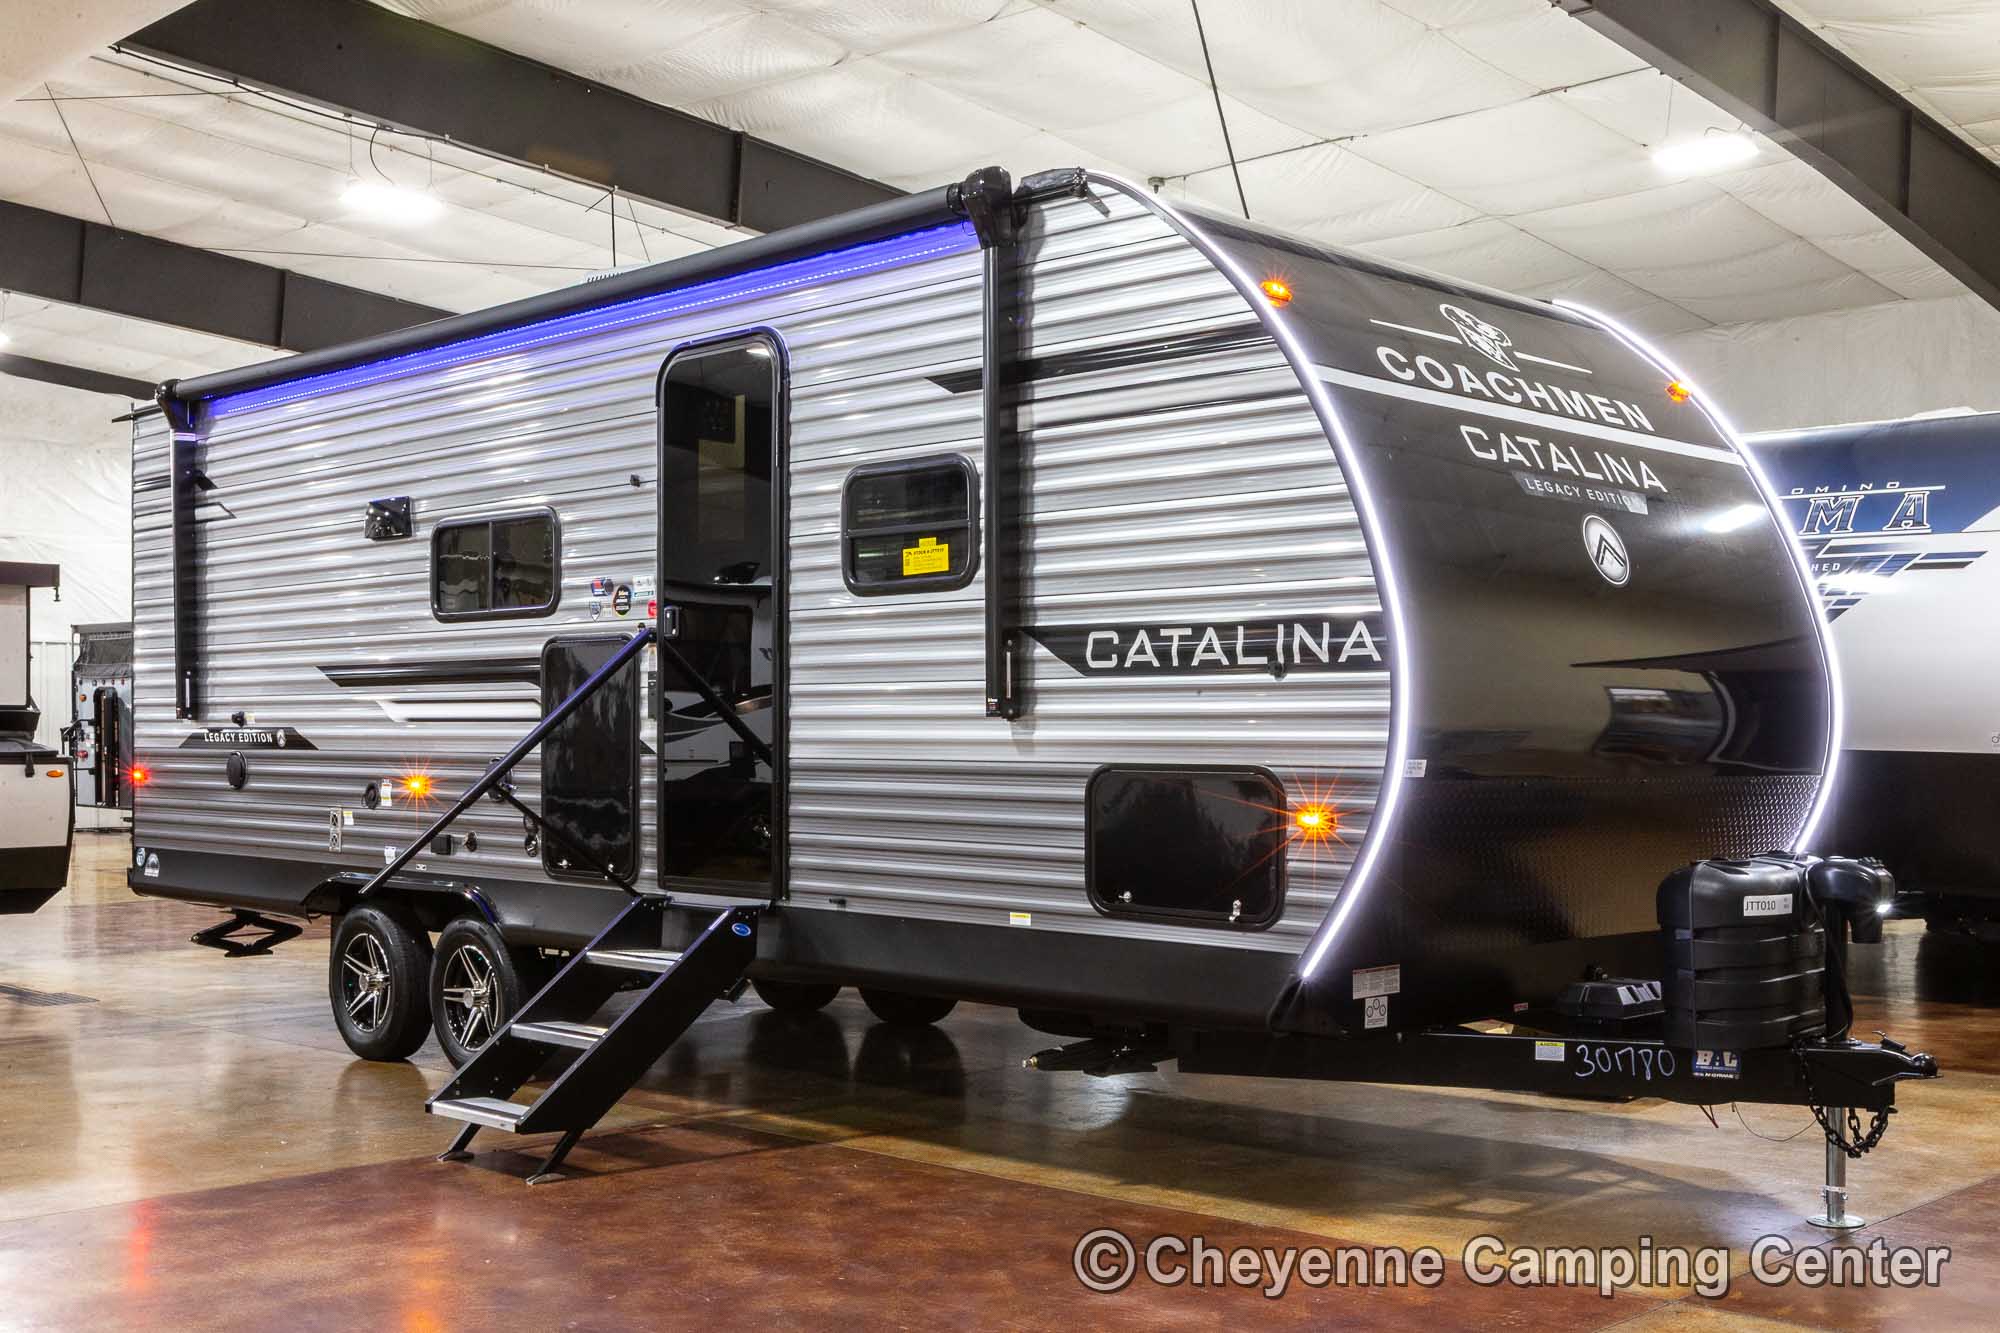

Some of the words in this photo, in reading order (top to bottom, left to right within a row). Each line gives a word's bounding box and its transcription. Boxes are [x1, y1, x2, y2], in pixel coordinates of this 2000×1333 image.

[1376, 346, 1655, 432] COACHMEN
[1459, 425, 1668, 492] CATALINA
[1524, 478, 1581, 498] LEGACY
[1586, 488, 1642, 507] EDITIO
[1791, 481, 1900, 495] OMINO
[1085, 620, 1383, 669] CATALINA
[204, 732, 235, 743] LEGACY
[239, 732, 273, 743] EDITION
[1744, 900, 1776, 911] JTT010
